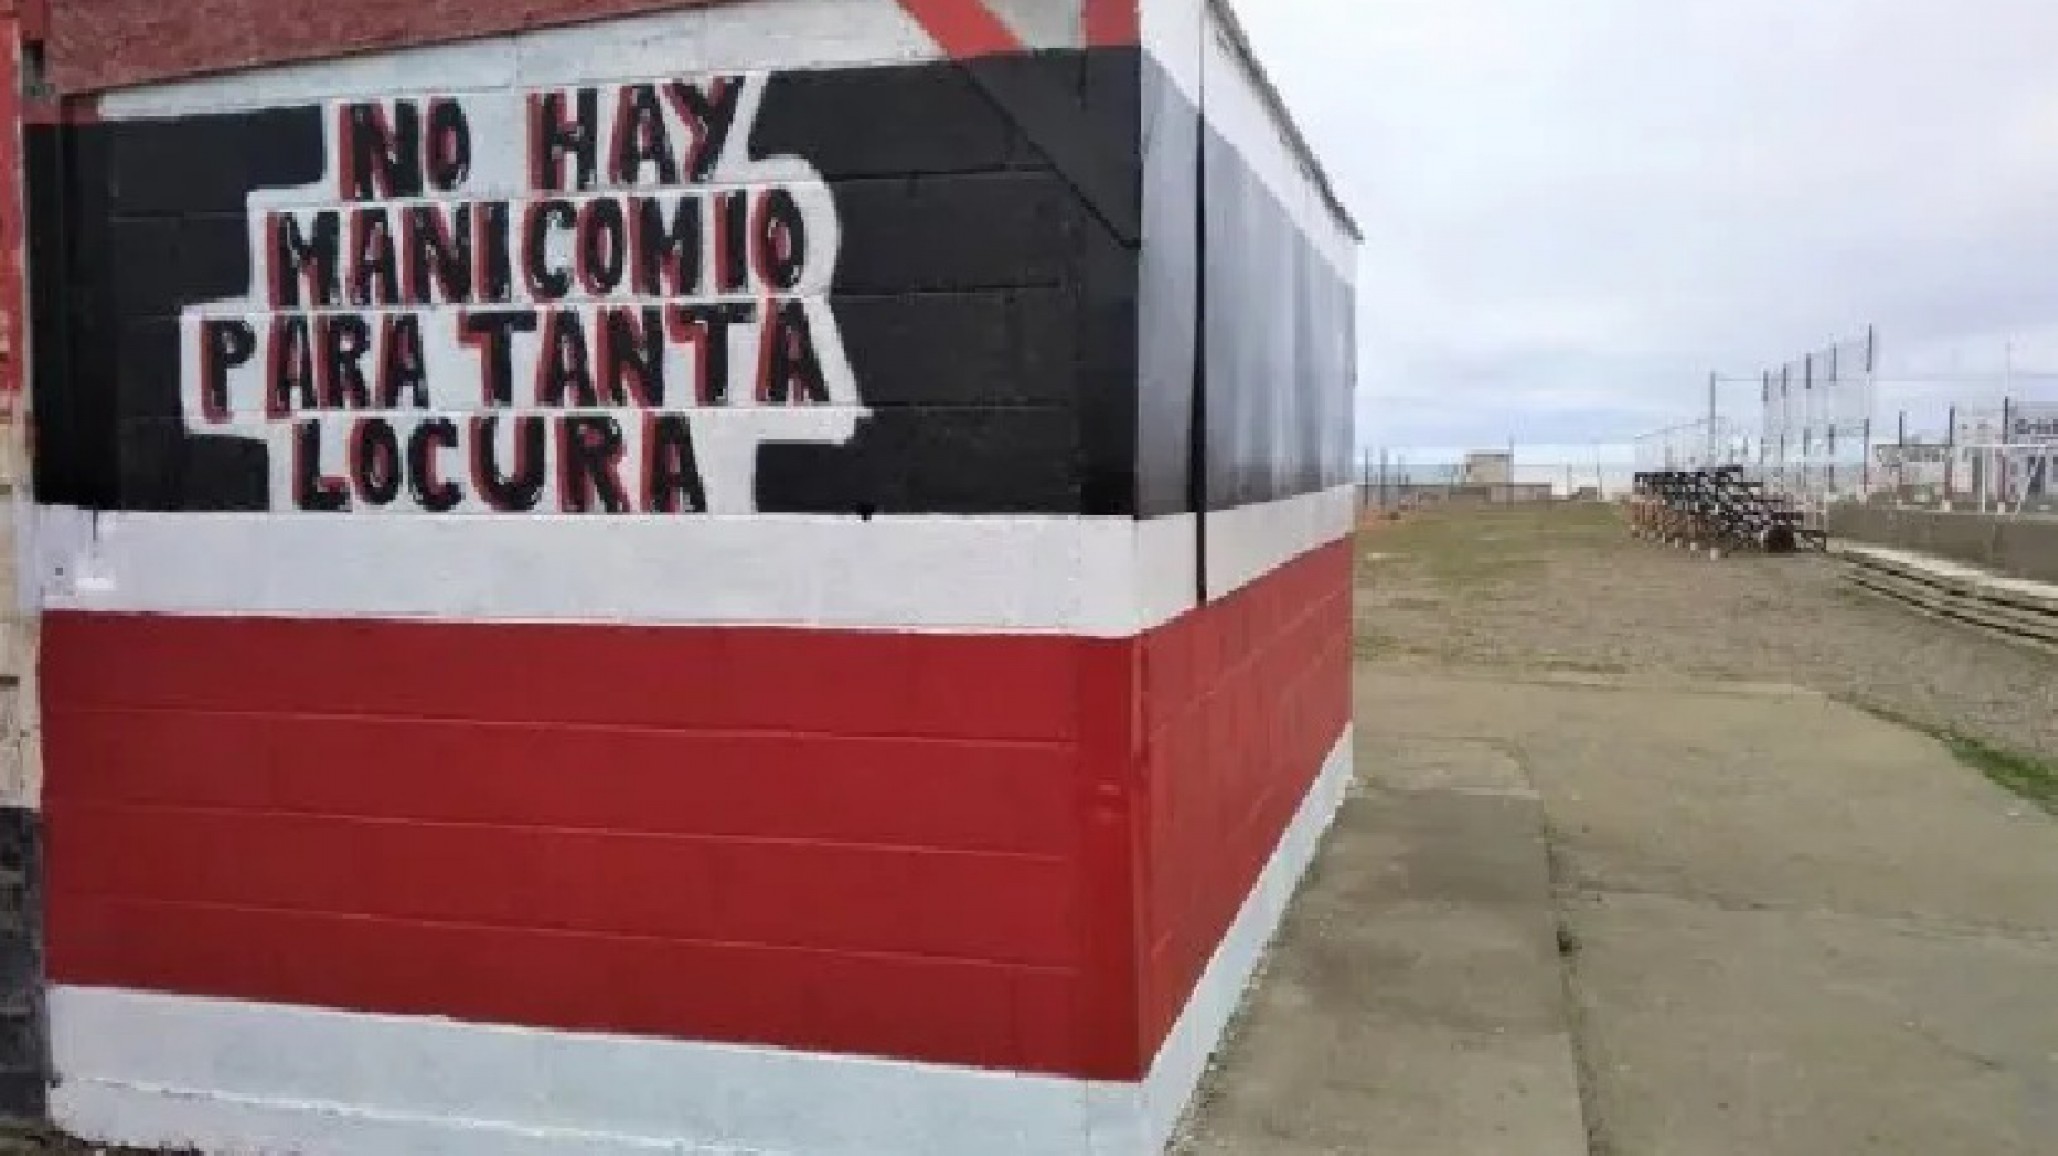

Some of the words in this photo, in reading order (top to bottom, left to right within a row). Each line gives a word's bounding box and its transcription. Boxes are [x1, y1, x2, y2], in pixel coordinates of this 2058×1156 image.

[339, 96, 471, 200] NO
[526, 76, 745, 191] HAY
[266, 189, 803, 308] MANICOMIO
[201, 312, 428, 423] PARA
[458, 297, 830, 406] TANTA
[292, 412, 707, 513] LOCURA
